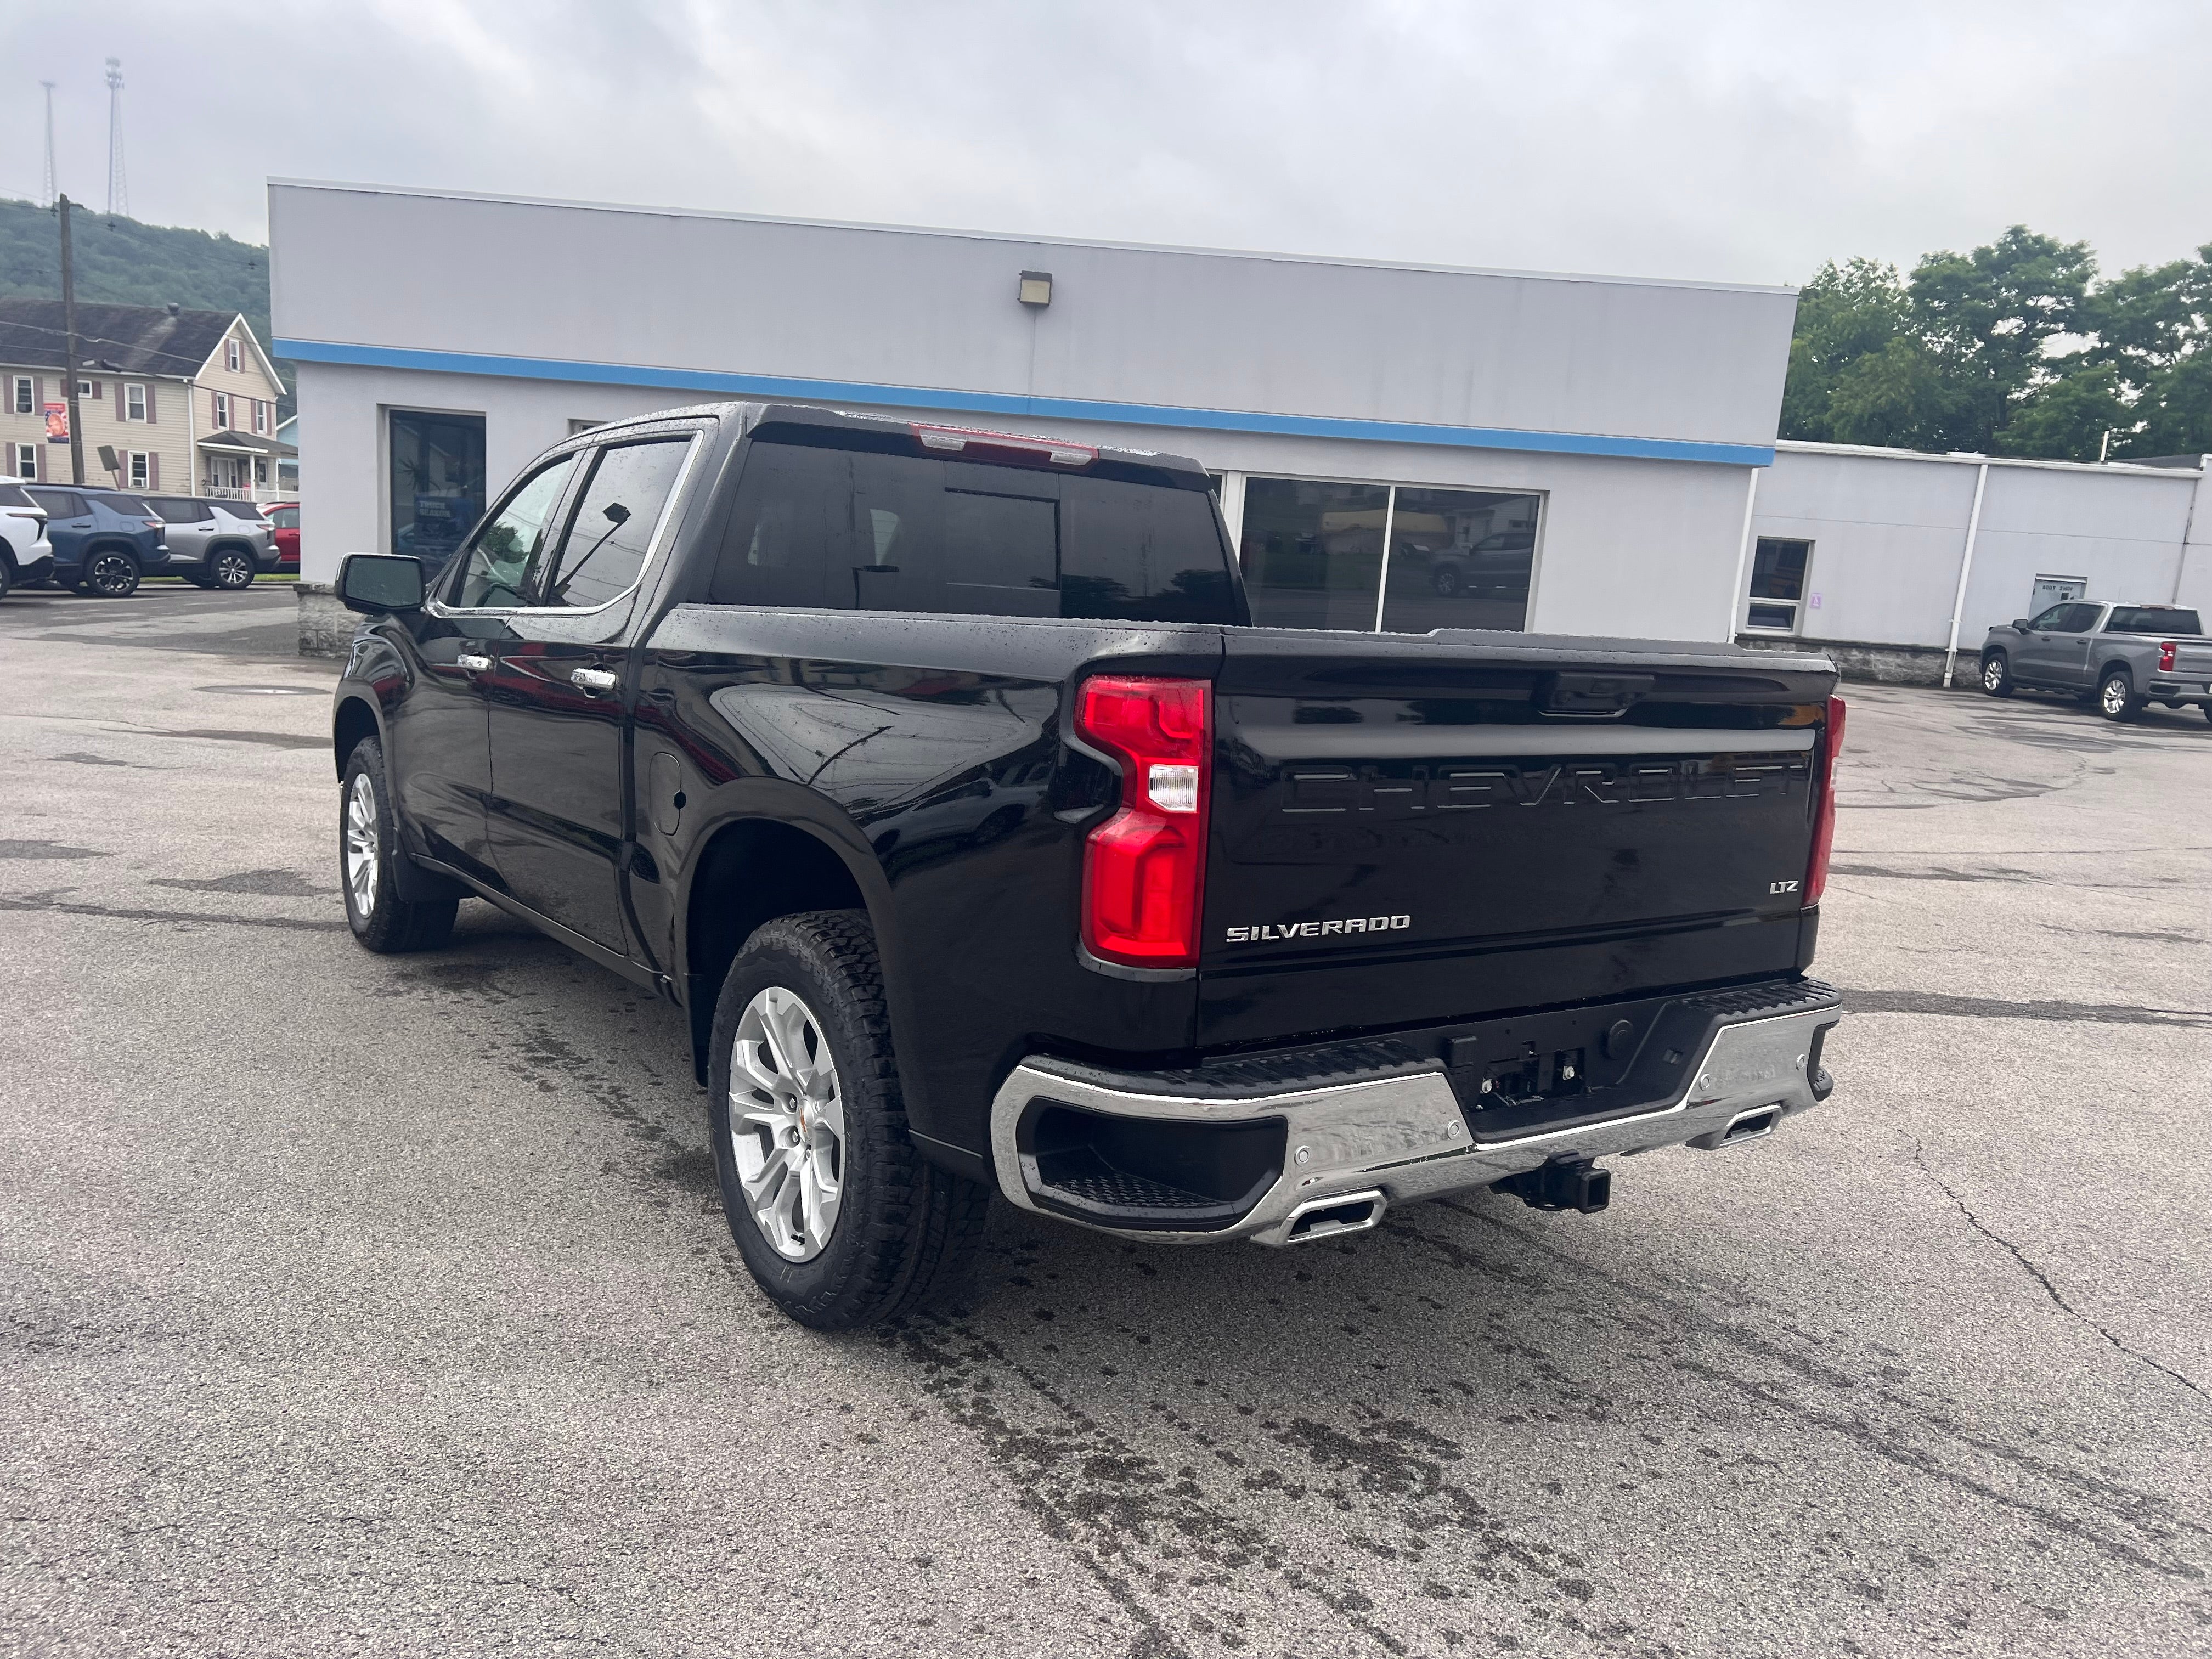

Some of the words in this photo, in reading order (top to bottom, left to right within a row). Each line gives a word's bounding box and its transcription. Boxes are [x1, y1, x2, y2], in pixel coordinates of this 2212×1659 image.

[1280, 759, 1807, 812] CHEVROLET
[1769, 880, 1799, 894] LTZ
[1226, 915, 1410, 943] SILVERADO
